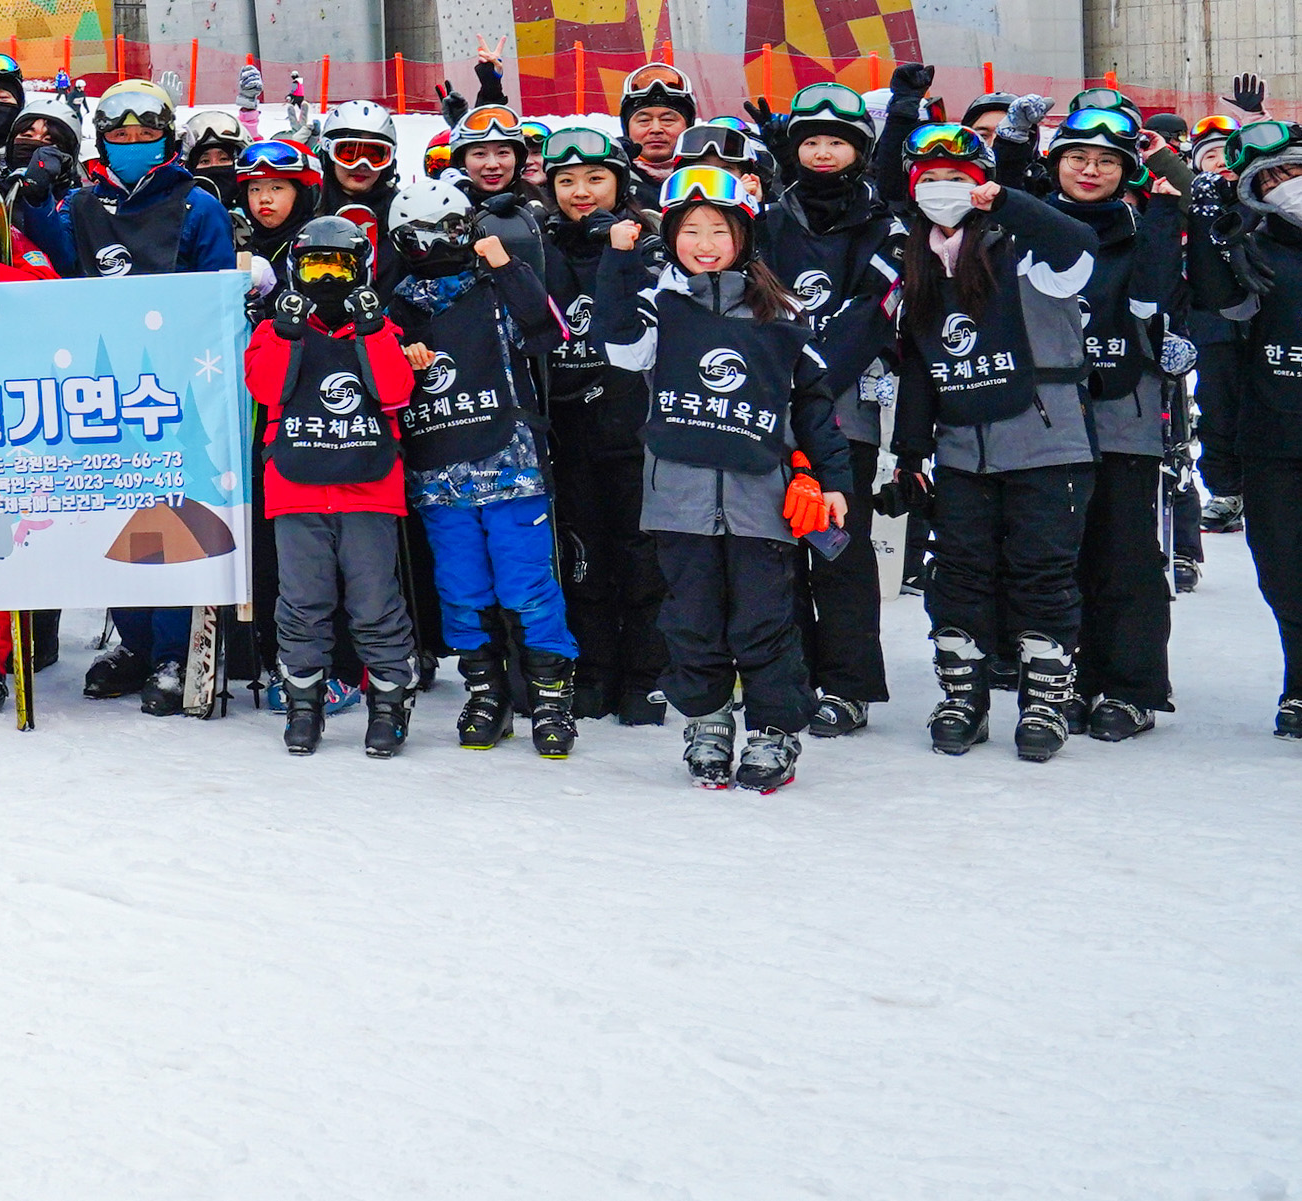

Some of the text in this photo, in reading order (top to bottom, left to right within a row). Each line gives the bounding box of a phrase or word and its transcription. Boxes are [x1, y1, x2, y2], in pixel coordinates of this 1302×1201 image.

[930, 351, 1016, 382] 국체육회
[939, 377, 1007, 393] SPORTS ASSOCIATION
[403, 389, 499, 428] 한국체육회
[658, 390, 777, 433] 한국체육회
[284, 416, 381, 438] 한국체육회
[425, 423, 446, 433] SPORTS
[447, 415, 492, 427] ASSOCIATION
[666, 416, 762, 442] KOREA SPORTS ASSOCIATION
[339, 440, 377, 449] ASSOCIATION
